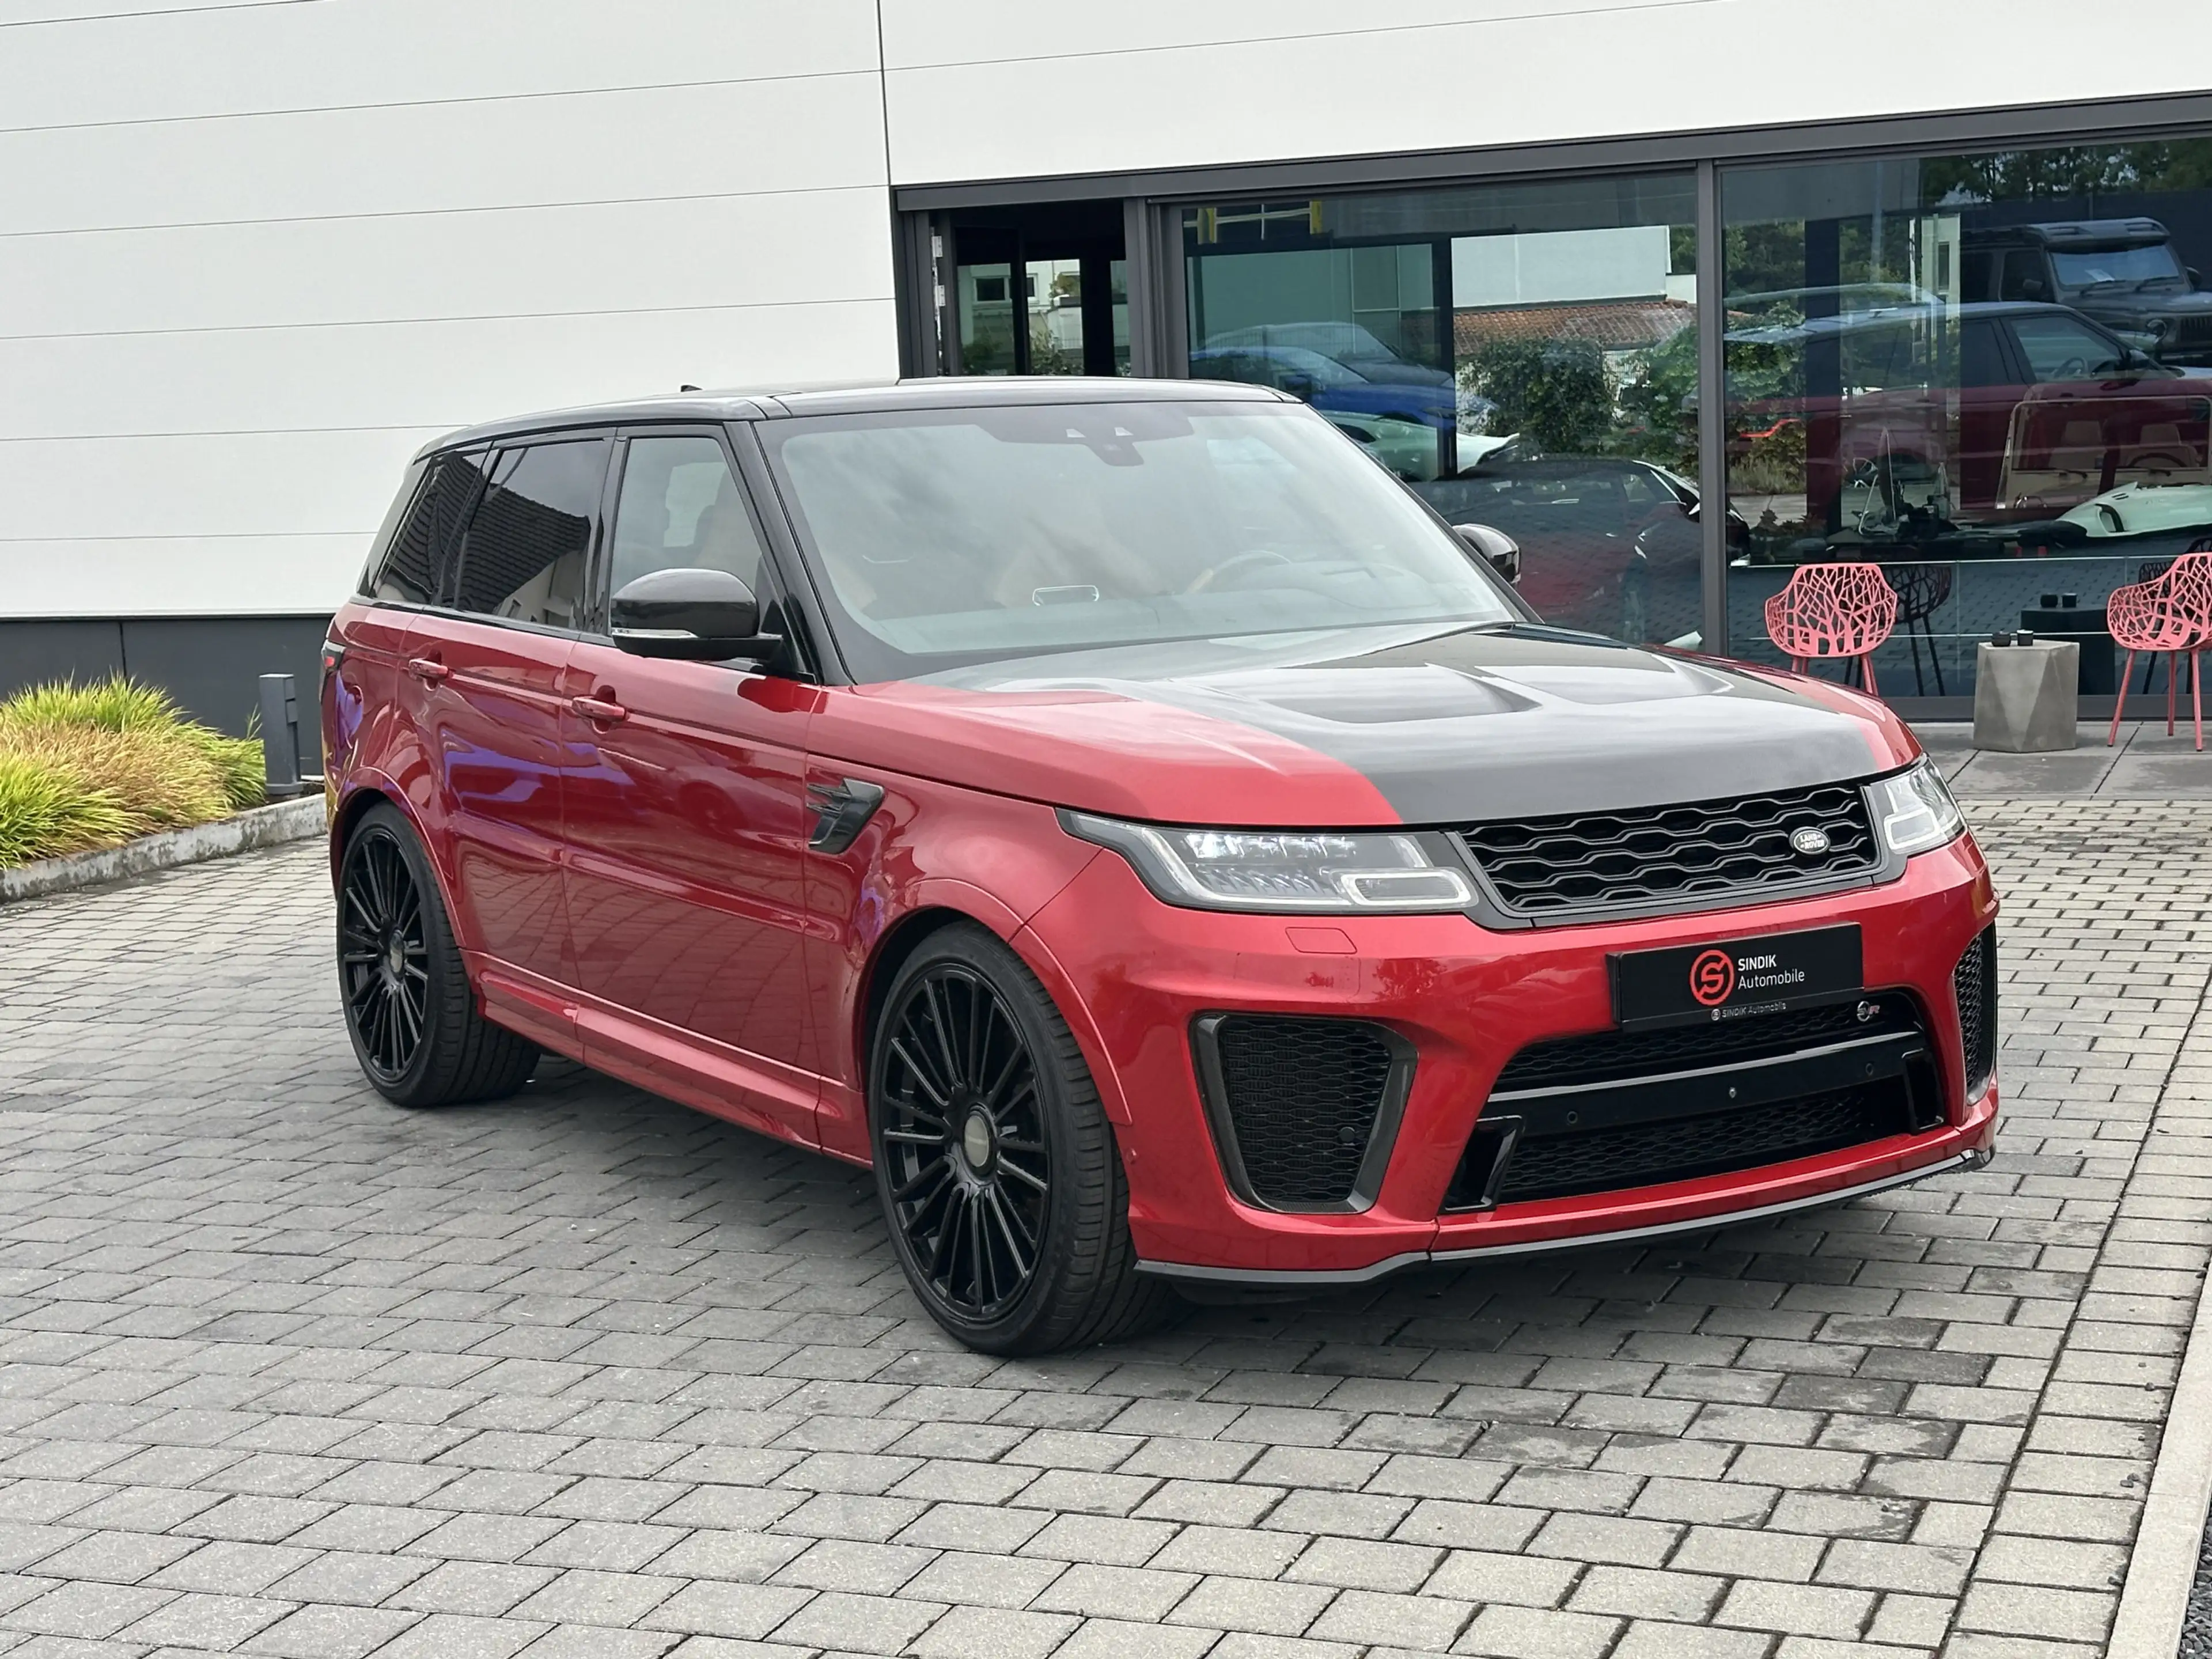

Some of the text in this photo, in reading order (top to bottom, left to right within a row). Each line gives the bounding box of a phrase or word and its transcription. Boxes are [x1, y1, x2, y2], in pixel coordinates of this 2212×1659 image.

[1737, 955, 1777, 972] SINDIK
[1737, 968, 1805, 990] Automobile
[1722, 1001, 1787, 1018] SINDIK Automobile
